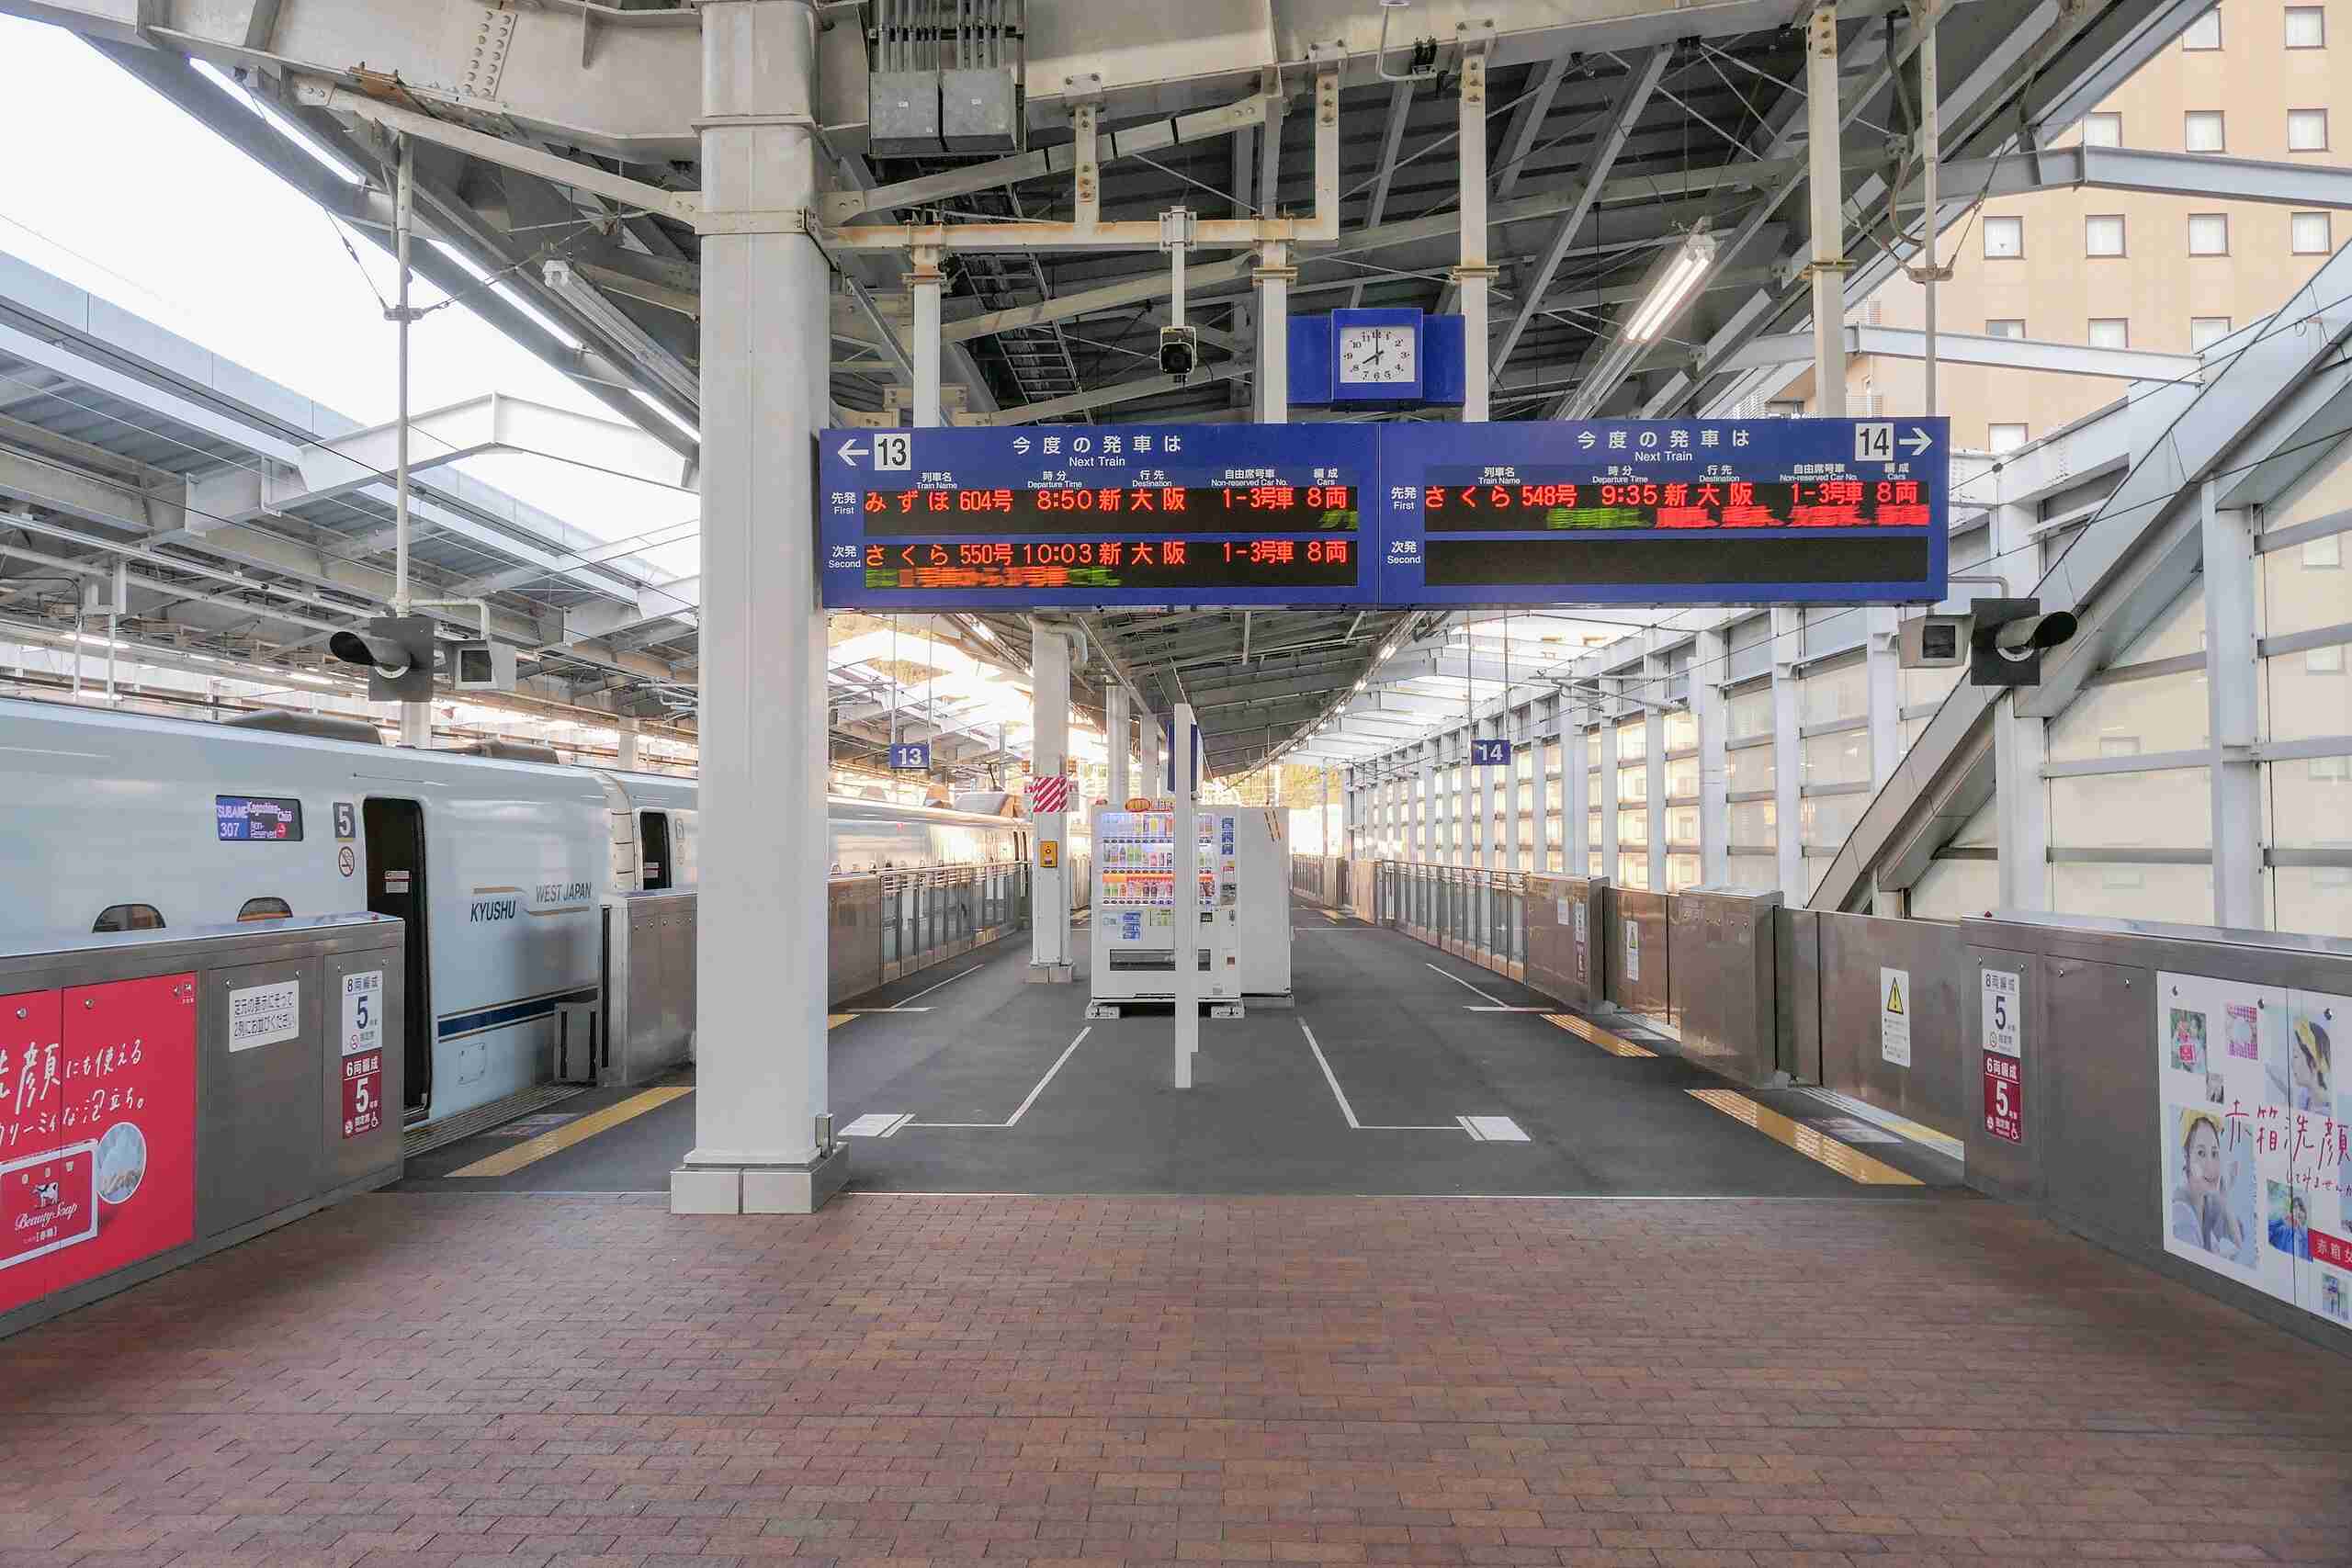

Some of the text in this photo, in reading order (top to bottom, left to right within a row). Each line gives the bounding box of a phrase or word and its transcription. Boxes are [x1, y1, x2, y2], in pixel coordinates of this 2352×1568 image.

[1577, 429, 1749, 449] 今度の発車は
[1859, 428, 1890, 457] 14
[1012, 435, 1182, 456] 今度の発車は
[877, 438, 908, 467] 13
[1634, 451, 1692, 462] Next Train
[1069, 457, 1125, 467] Next Train
[1139, 469, 1164, 480] 行先
[1225, 468, 1275, 479] 自由席号車
[1484, 467, 1515, 478] 列車名
[1707, 464, 1733, 475] 行先
[922, 471, 952, 482] 列車名
[1592, 476, 1648, 484] Departure Time
[1780, 474, 1859, 482] Non-reserved Car No.
[936, 481, 957, 490] Name
[1027, 480, 1082, 490] Departure Time
[1132, 479, 1172, 488] Destination
[1211, 479, 1288, 487] Non-reserved Car No.
[831, 491, 856, 504] 先発
[865, 486, 1348, 513] みずほ 604号 8:50 新大阪 1-3号車 8両
[1391, 487, 1417, 500] 先発
[1425, 481, 1917, 508] さくら 548号 9:35 新大阪 1-3号車 8両
[833, 506, 854, 514] First
[1393, 502, 1415, 510] First
[831, 546, 857, 558] 次発
[1391, 541, 1417, 553] 次発
[865, 541, 1348, 567] さくら 550号 10:03 新大阪 1-3号車 8両
[1387, 555, 1420, 565] Second
[829, 559, 861, 569] Second
[898, 748, 922, 764] 13
[1479, 744, 1503, 761] 14
[338, 806, 351, 836] 5
[220, 822, 240, 837] 307
[536, 882, 592, 903] WEST JAPAN
[470, 899, 516, 922] KYUSHU
[356, 996, 368, 1029] 5
[1996, 996, 2006, 1030] 5
[356, 1078, 368, 1112] 5
[1996, 1080, 2007, 1116] 5
